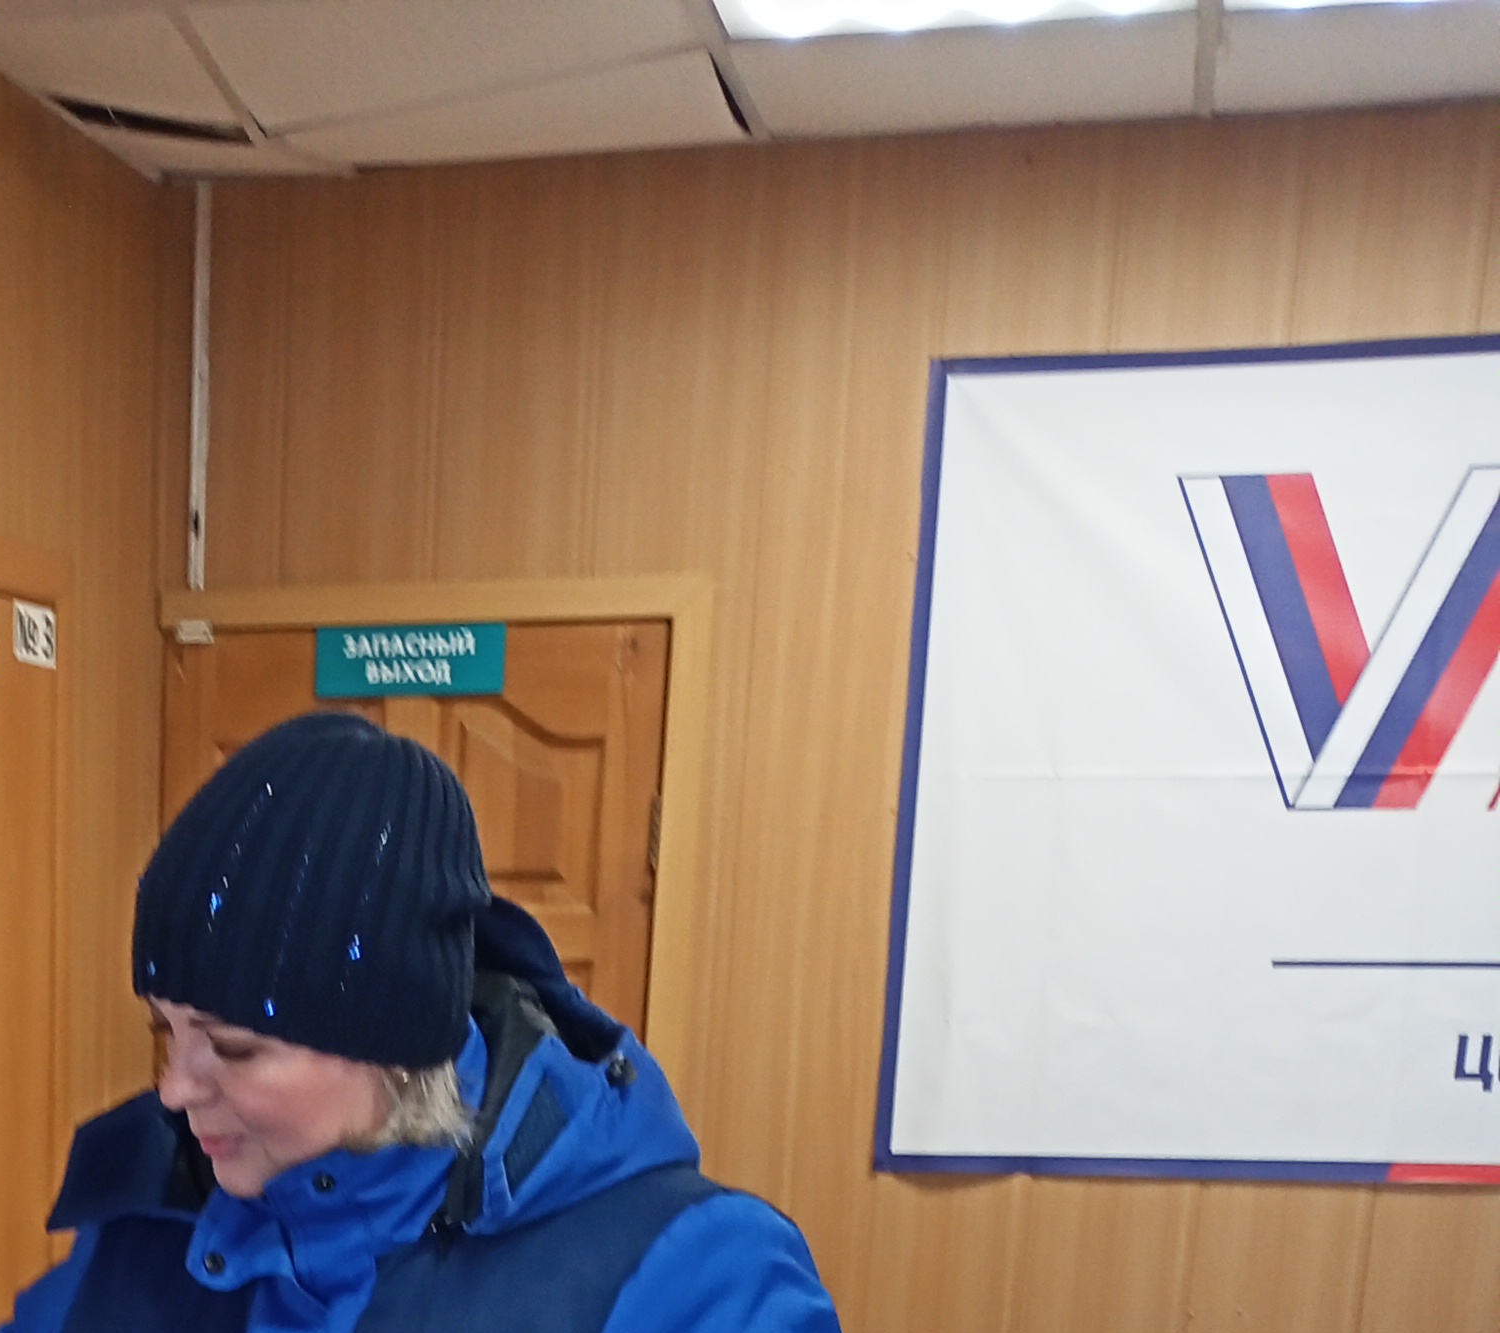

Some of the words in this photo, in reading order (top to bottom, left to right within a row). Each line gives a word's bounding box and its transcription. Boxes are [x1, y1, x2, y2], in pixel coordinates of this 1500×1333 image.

[342, 625, 476, 659] ЗАПАСНЫЙ
[365, 658, 452, 686] ВЫХОД
[1453, 1033, 1500, 1092] Ц
